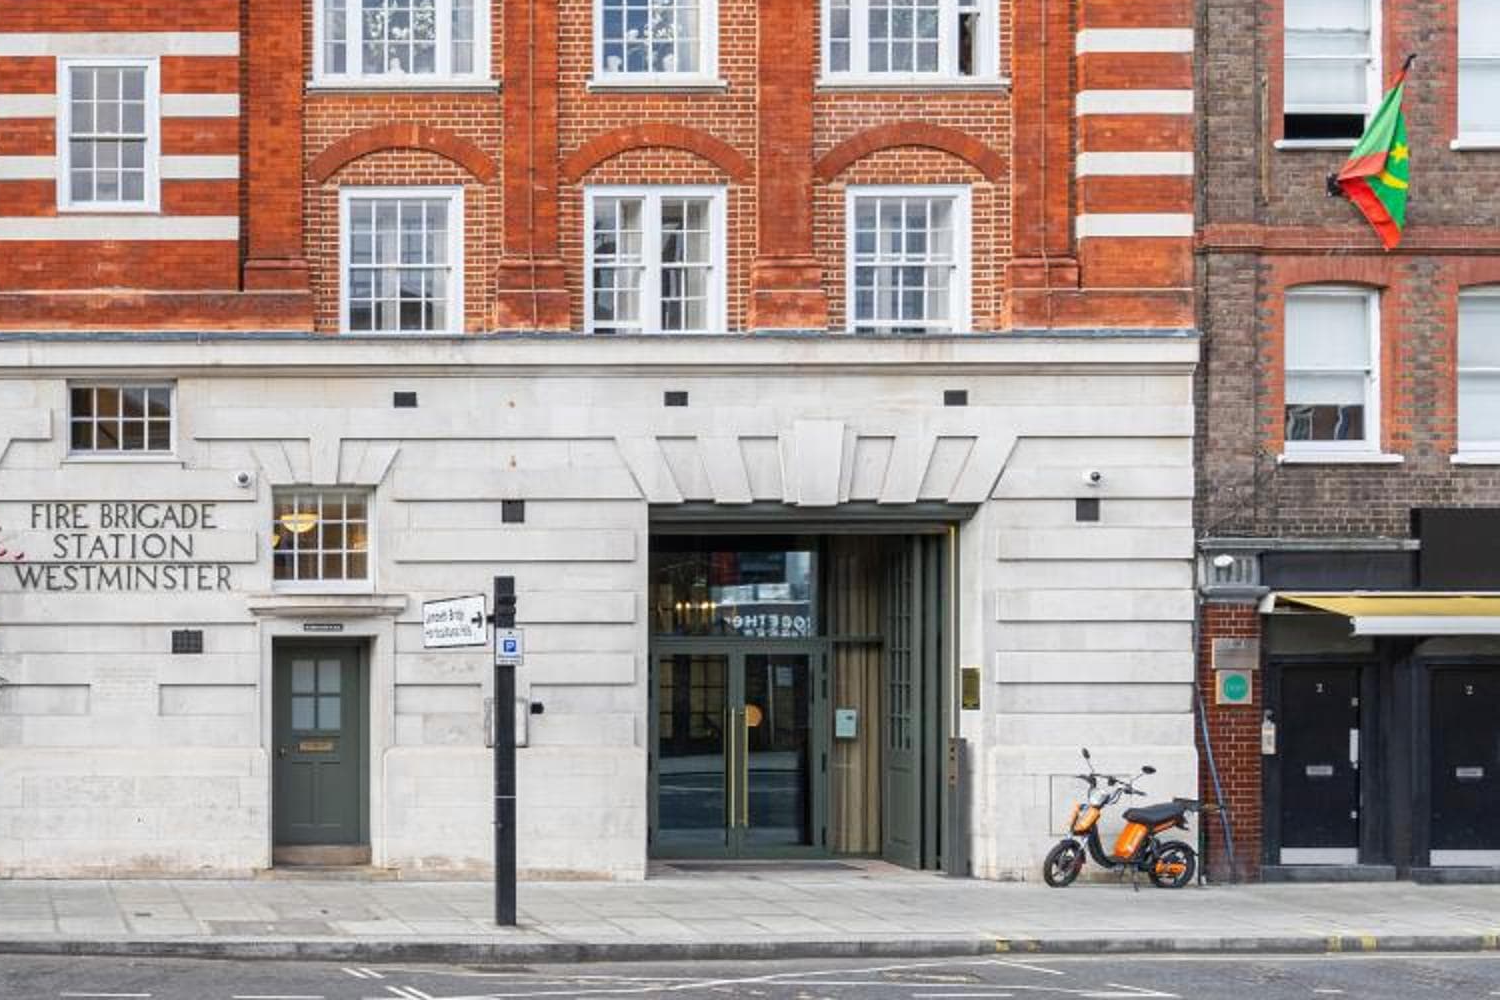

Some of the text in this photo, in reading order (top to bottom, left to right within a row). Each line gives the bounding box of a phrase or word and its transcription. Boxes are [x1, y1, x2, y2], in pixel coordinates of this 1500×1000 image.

[31, 504, 217, 529] FIRE BRIGADE
[53, 534, 193, 559] STATION
[15, 565, 231, 591] WESTMINSTER
